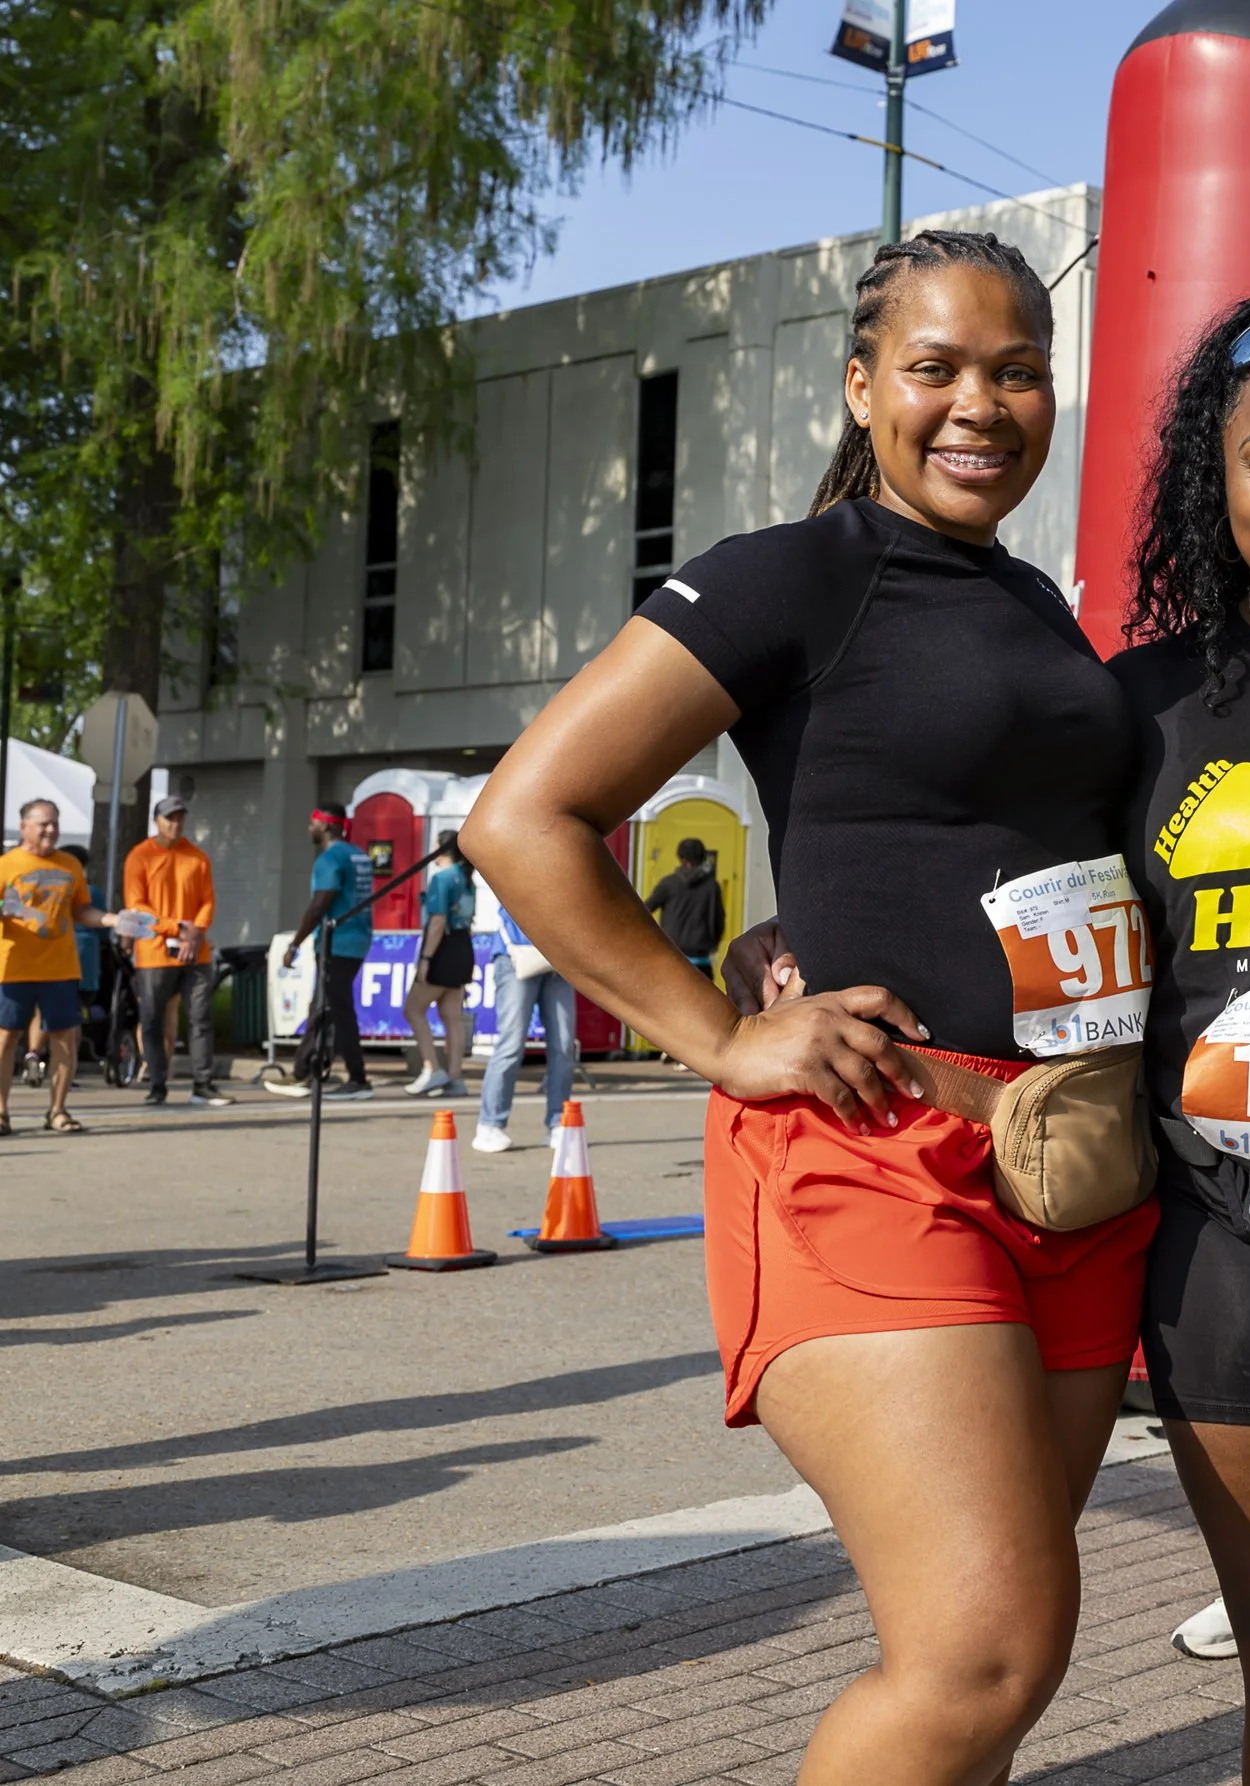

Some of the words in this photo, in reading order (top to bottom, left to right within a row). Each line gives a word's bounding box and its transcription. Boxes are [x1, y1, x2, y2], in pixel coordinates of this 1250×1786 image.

[1153, 758, 1233, 865] Health
[1008, 878, 1063, 903] Courir
[1067, 873, 1087, 890] du
[1088, 865, 1129, 884] Festiva
[1091, 891, 1103, 900] 5K
[1103, 889, 1117, 899] Run
[1047, 904, 1153, 998] 972
[361, 962, 497, 1009] FIS
